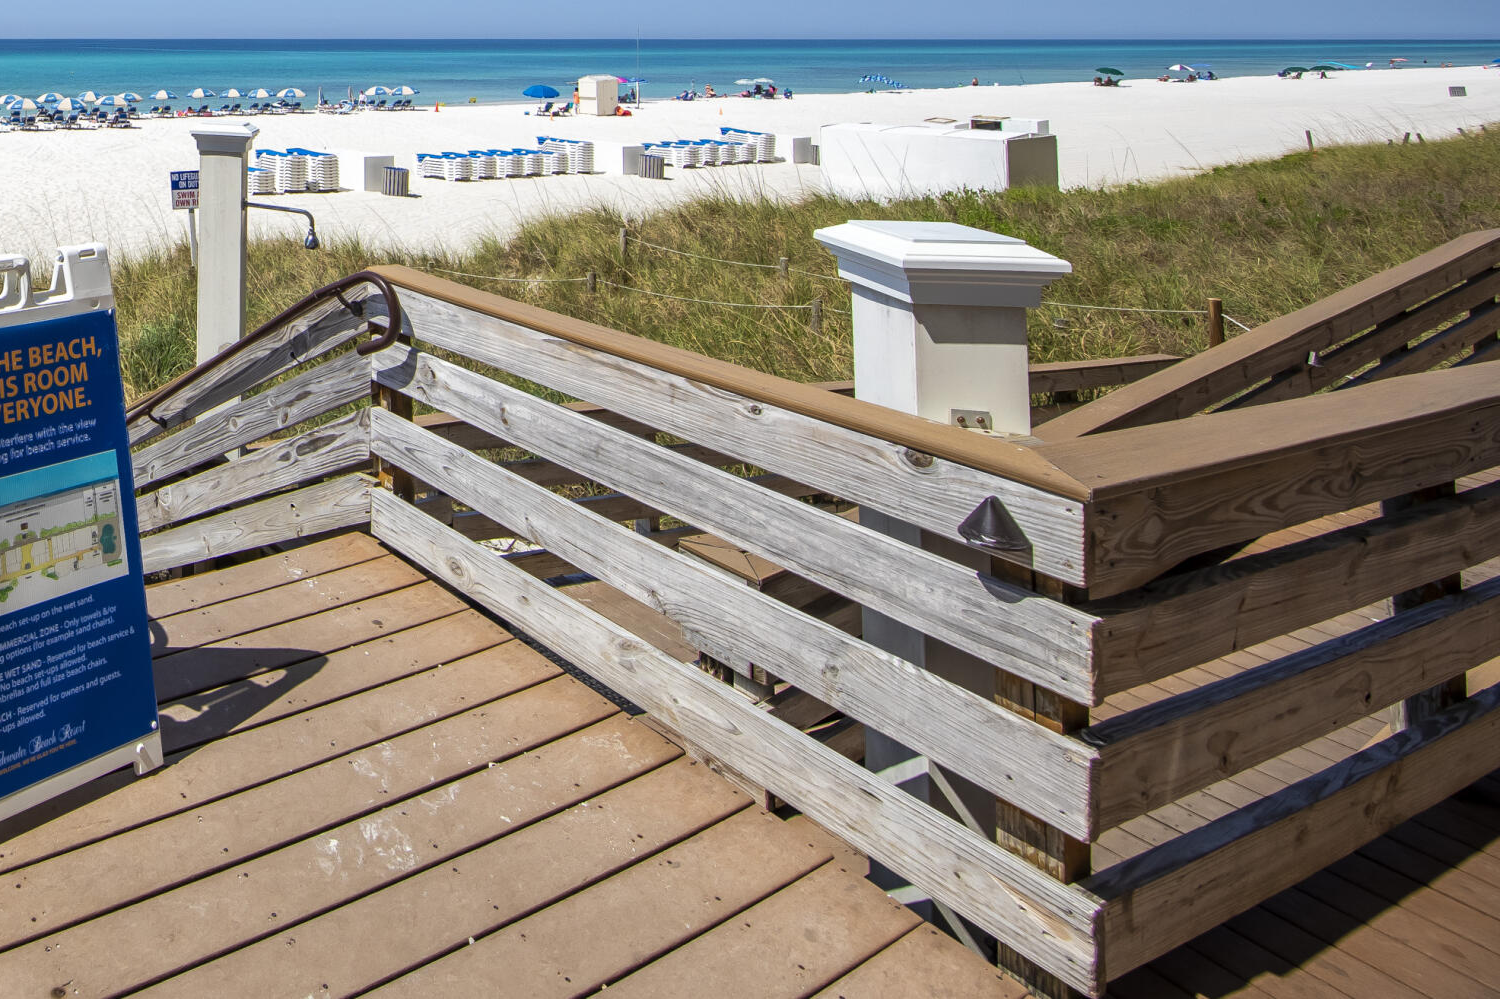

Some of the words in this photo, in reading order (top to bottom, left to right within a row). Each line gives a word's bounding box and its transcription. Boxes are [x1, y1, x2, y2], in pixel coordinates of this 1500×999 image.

[172, 173, 179, 181] NO
[180, 172, 199, 181] LIFEGU
[178, 180, 187, 189] ON
[187, 180, 199, 189] DUT
[175, 199, 191, 207] OWN
[192, 199, 200, 207] RI
[177, 191, 195, 199] SWIM
[28, 336, 101, 367] BEACH,
[0, 376, 18, 399] IS
[23, 362, 89, 394] ROOM
[35, 425, 56, 440] with
[58, 422, 74, 434] the
[75, 418, 96, 430] view
[10, 448, 24, 459] for
[26, 439, 55, 456] beach
[56, 433, 91, 448] service.
[18, 614, 40, 626] set-up
[41, 610, 50, 618] on
[51, 605, 63, 615] the
[63, 601, 76, 611] wet
[77, 594, 94, 606] sand.
[39, 624, 59, 637] ZONE
[64, 618, 80, 629] Only
[80, 610, 102, 623] towels
[103, 605, 117, 616] &/or
[5, 645, 32, 660] options
[33, 640, 45, 651] (for
[46, 630, 74, 646] example
[75, 623, 91, 636] sand
[92, 616, 115, 630] chairs).
[5, 667, 21, 677] WET
[21, 659, 42, 673] SAND
[46, 648, 76, 664] Reserved
[77, 644, 86, 653] for
[87, 636, 107, 649] beach
[107, 629, 129, 642] service
[129, 625, 135, 634] &
[0, 682, 10, 692] No
[12, 673, 32, 686] beach
[34, 665, 58, 680] set-ups
[59, 652, 87, 670] allowed.
[26, 681, 39, 694] and
[40, 676, 52, 688] full
[52, 673, 65, 683] size
[66, 664, 86, 678] beach
[87, 657, 108, 669] chairs.
[17, 697, 49, 716] Reserved
[49, 693, 60, 703] for
[60, 684, 85, 699] owners
[86, 677, 99, 689] and
[99, 670, 122, 686] guests.
[17, 709, 46, 727] allowed.
